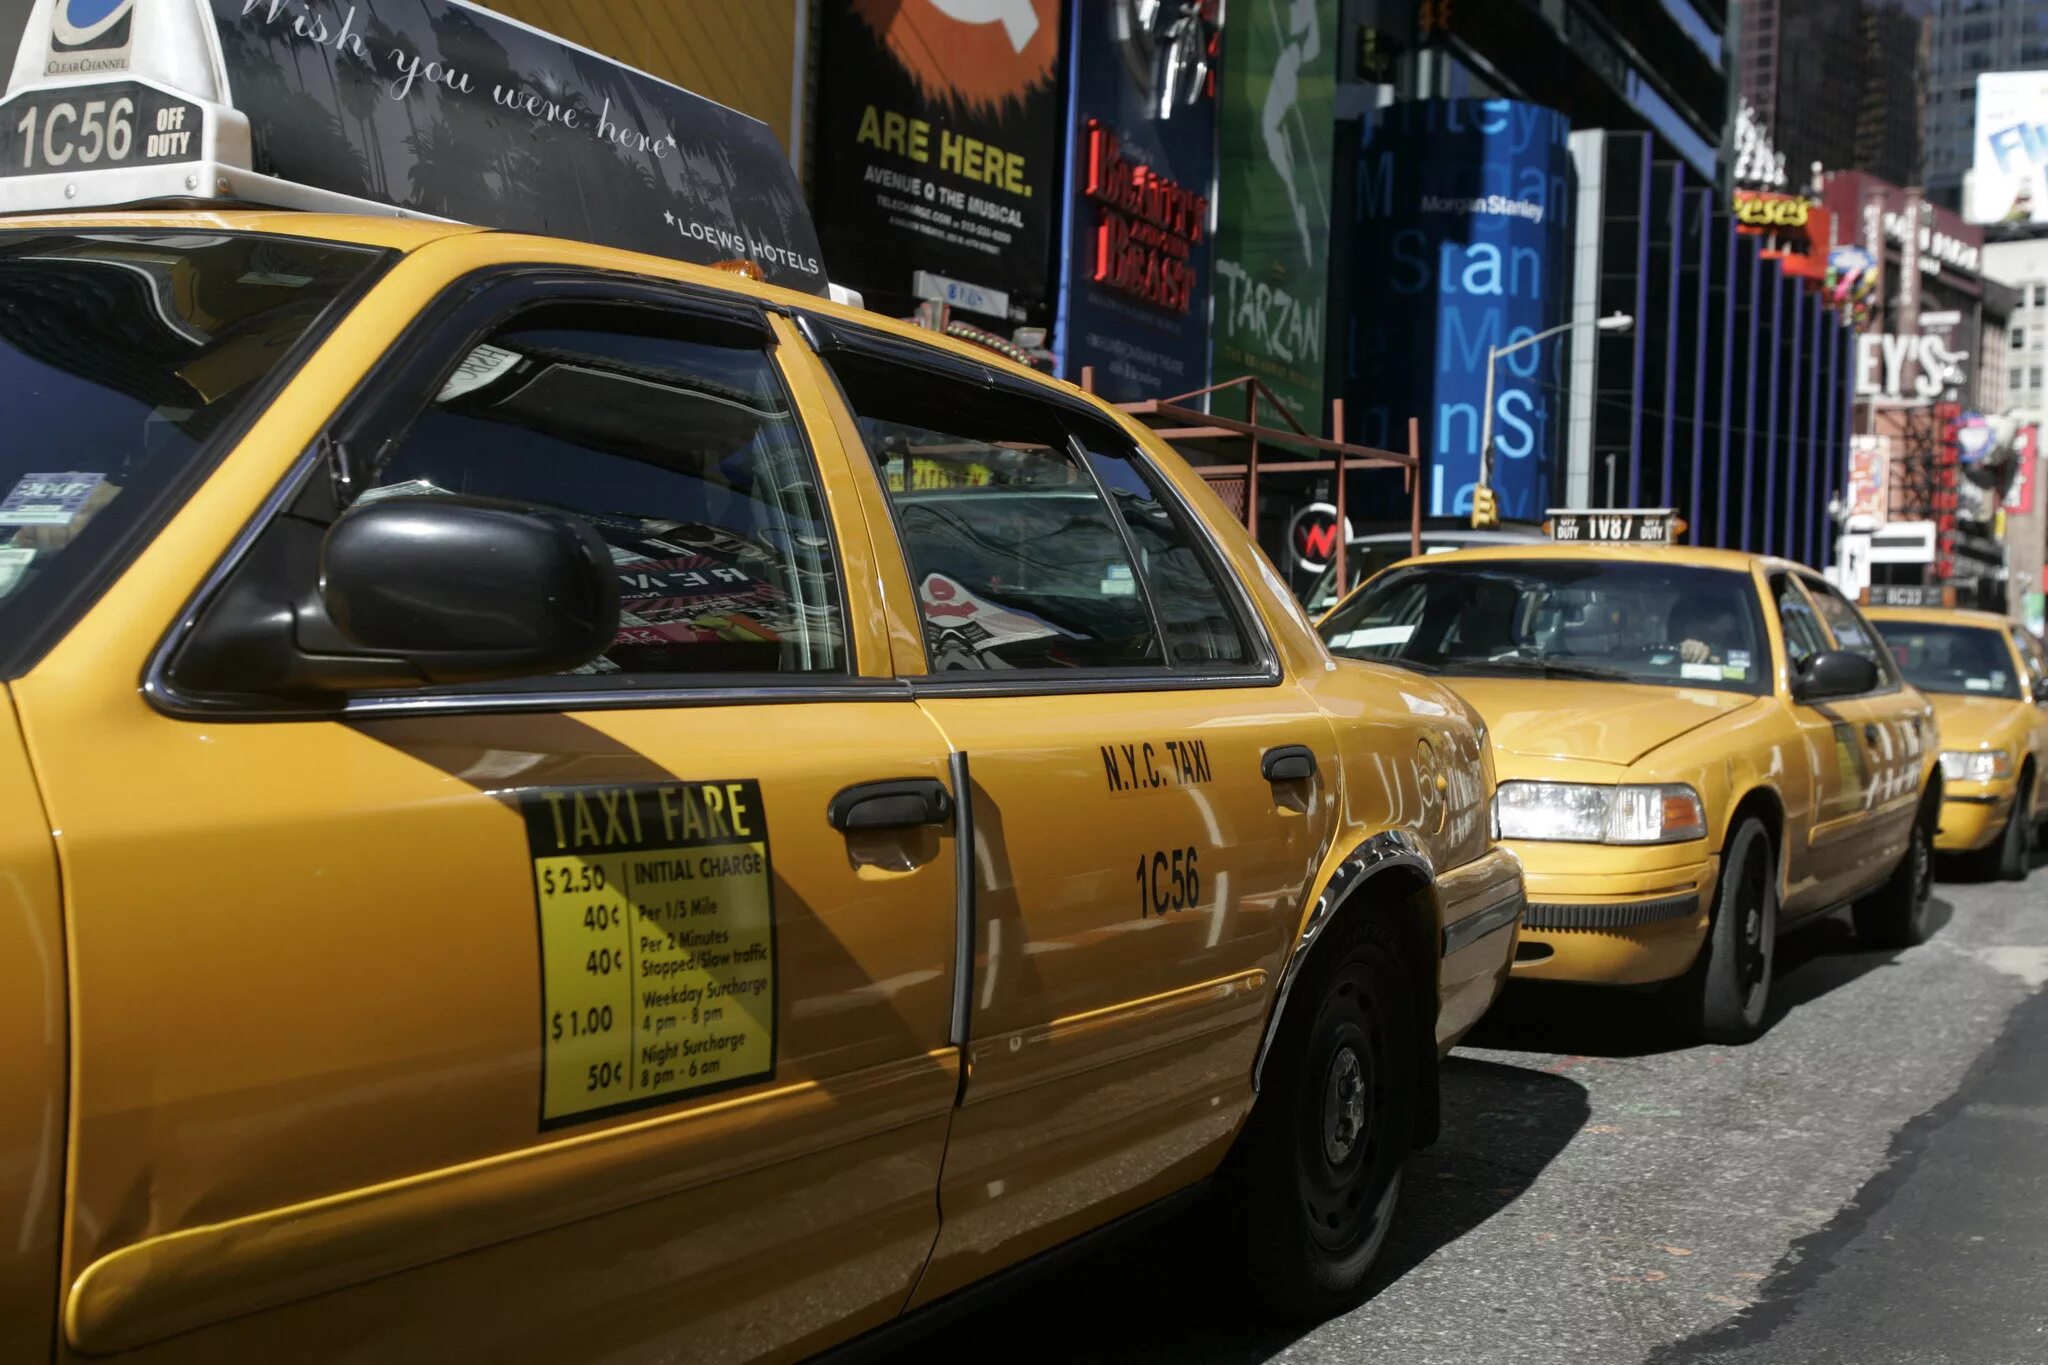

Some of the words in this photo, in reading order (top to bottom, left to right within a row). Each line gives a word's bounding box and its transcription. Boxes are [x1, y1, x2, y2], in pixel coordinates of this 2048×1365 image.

[387, 49, 474, 101] you
[493, 84, 581, 129] were
[17, 97, 134, 168] 1C56
[155, 106, 186, 132] OFF
[146, 131, 190, 158] DUTY
[856, 104, 931, 164] ARE
[939, 129, 1033, 198] HERE.
[863, 164, 922, 197] AVENUE
[923, 182, 937, 201] Q
[938, 186, 966, 211] THE
[967, 196, 1025, 229] MUSICAL
[677, 217, 746, 253] LOEWS
[752, 242, 820, 275] HOTELS
[1216, 258, 1322, 364] TARZAN
[1557, 525, 1580, 540] DUTY
[1588, 515, 1634, 540] 1V87
[1640, 526, 1664, 540] DUTY
[1100, 742, 1168, 792] N.Y.C.
[1165, 739, 1213, 785] TAXI
[542, 787, 645, 849] TAXI
[658, 783, 751, 842] FARE
[634, 858, 696, 885] INITIAL
[700, 853, 762, 879] CHARGE
[1136, 846, 1200, 919] 1C56
[638, 903, 661, 922] Per
[665, 900, 687, 920] 1/5
[690, 896, 718, 917] Mile
[640, 936, 662, 954] Per
[667, 932, 676, 950] 2
[679, 928, 729, 949] Minutes
[733, 942, 769, 965] traffic
[642, 983, 704, 1010] Weekday
[706, 976, 768, 999] Surcharge
[643, 1014, 652, 1032] 4
[656, 1016, 677, 1036] pm
[691, 1006, 699, 1025] 8
[703, 1007, 723, 1028] pm
[641, 1040, 679, 1067] Night
[683, 1033, 746, 1057] Surcharge
[641, 1068, 650, 1089] 8
[654, 1069, 675, 1091] pm
[688, 1060, 698, 1079] 6
[701, 1060, 720, 1075] am
